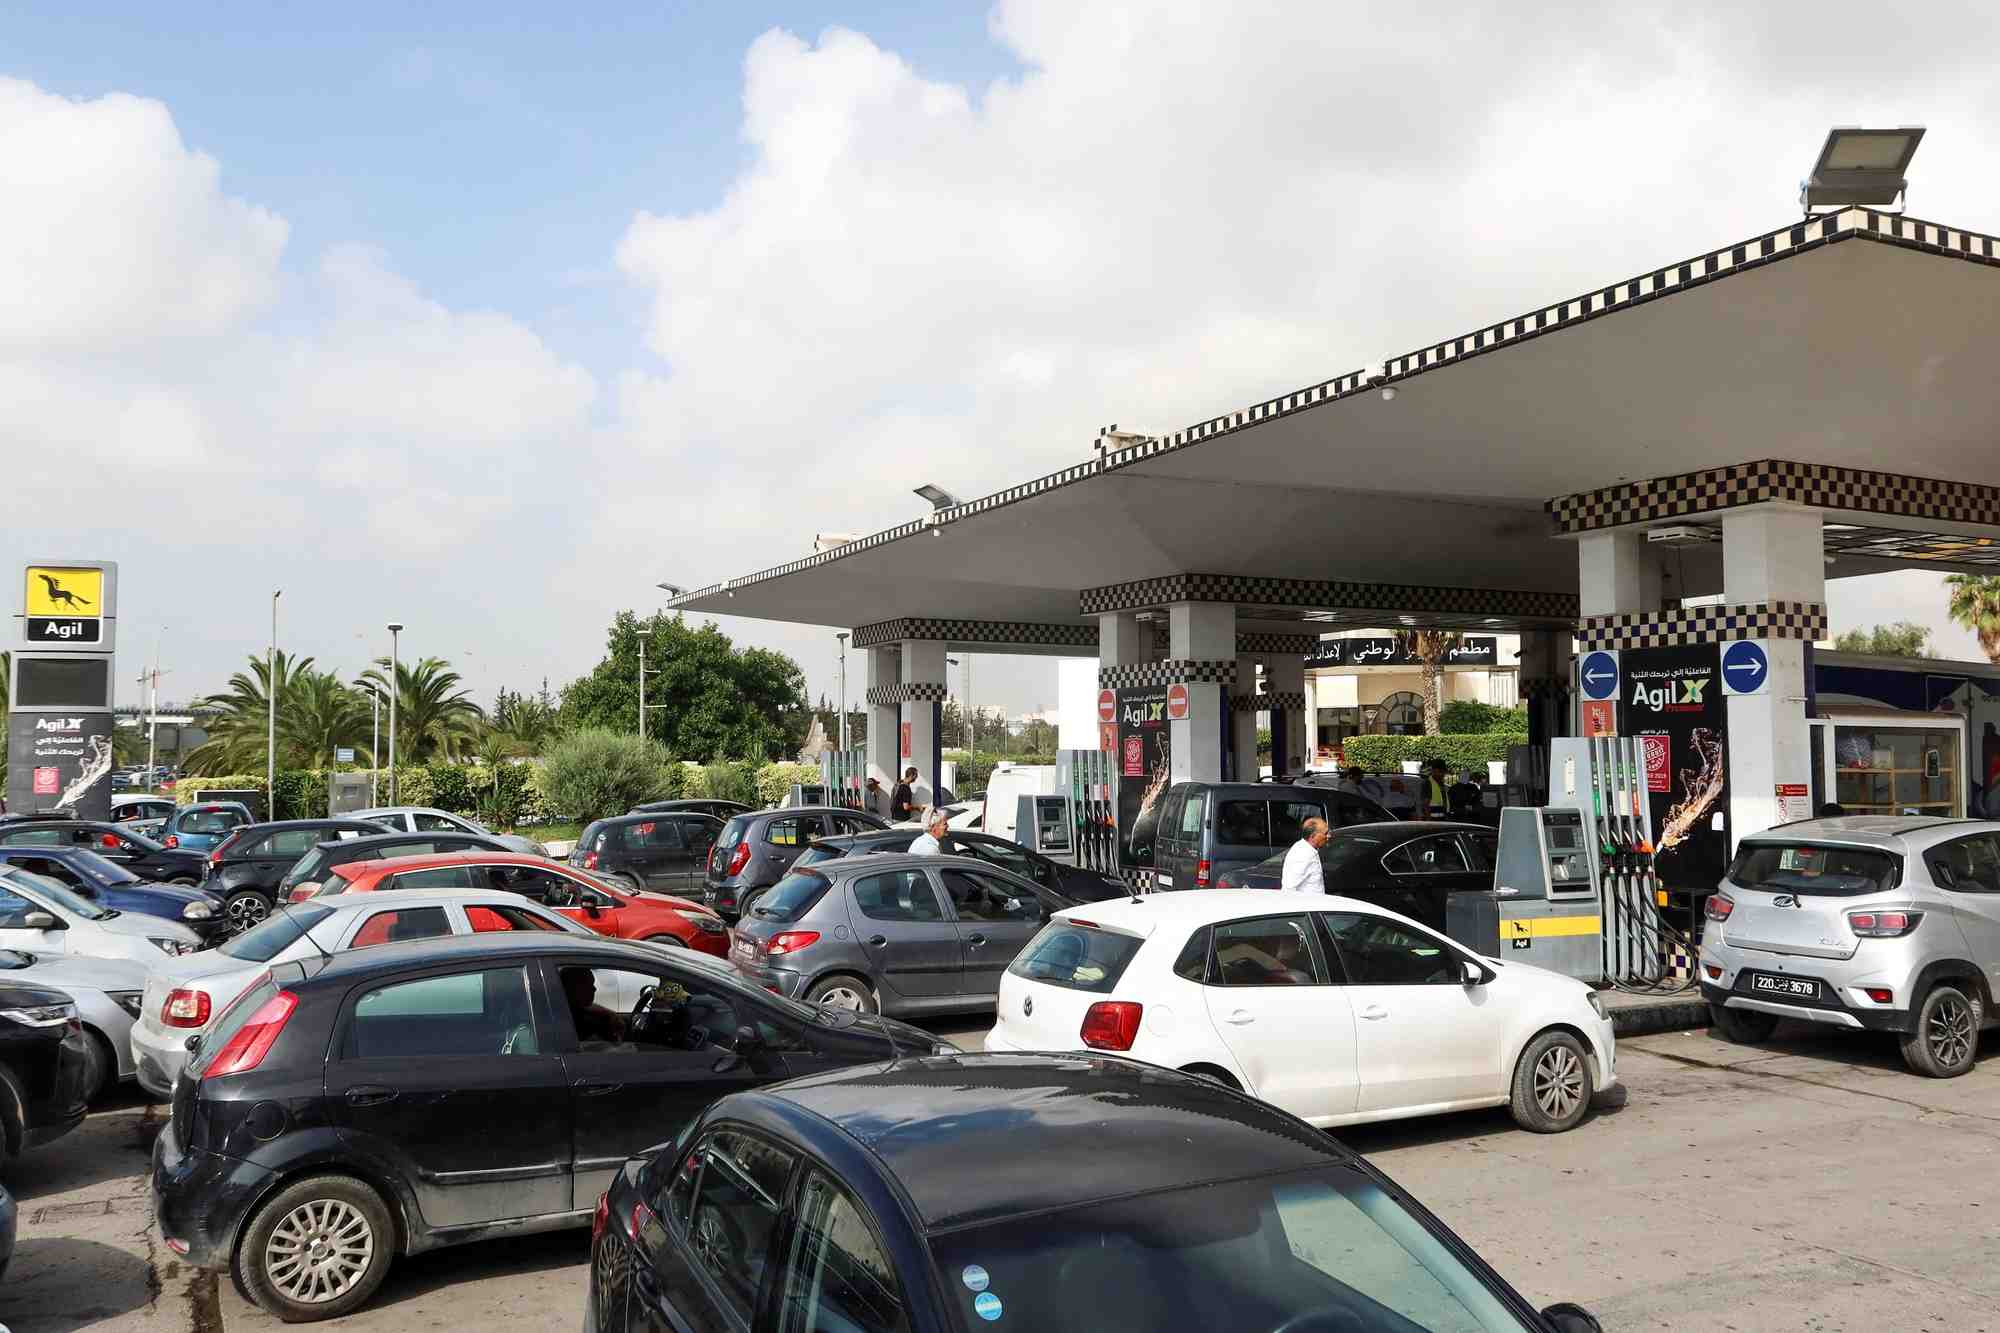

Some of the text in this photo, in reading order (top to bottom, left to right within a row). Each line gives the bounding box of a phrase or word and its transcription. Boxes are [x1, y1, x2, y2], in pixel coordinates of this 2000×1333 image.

[45, 621, 82, 639] Agil
[1353, 639, 1396, 664] لوطني
[1449, 639, 1490, 661] مطعم
[1758, 977, 1774, 989] 220
[1790, 981, 1813, 994] 3678
